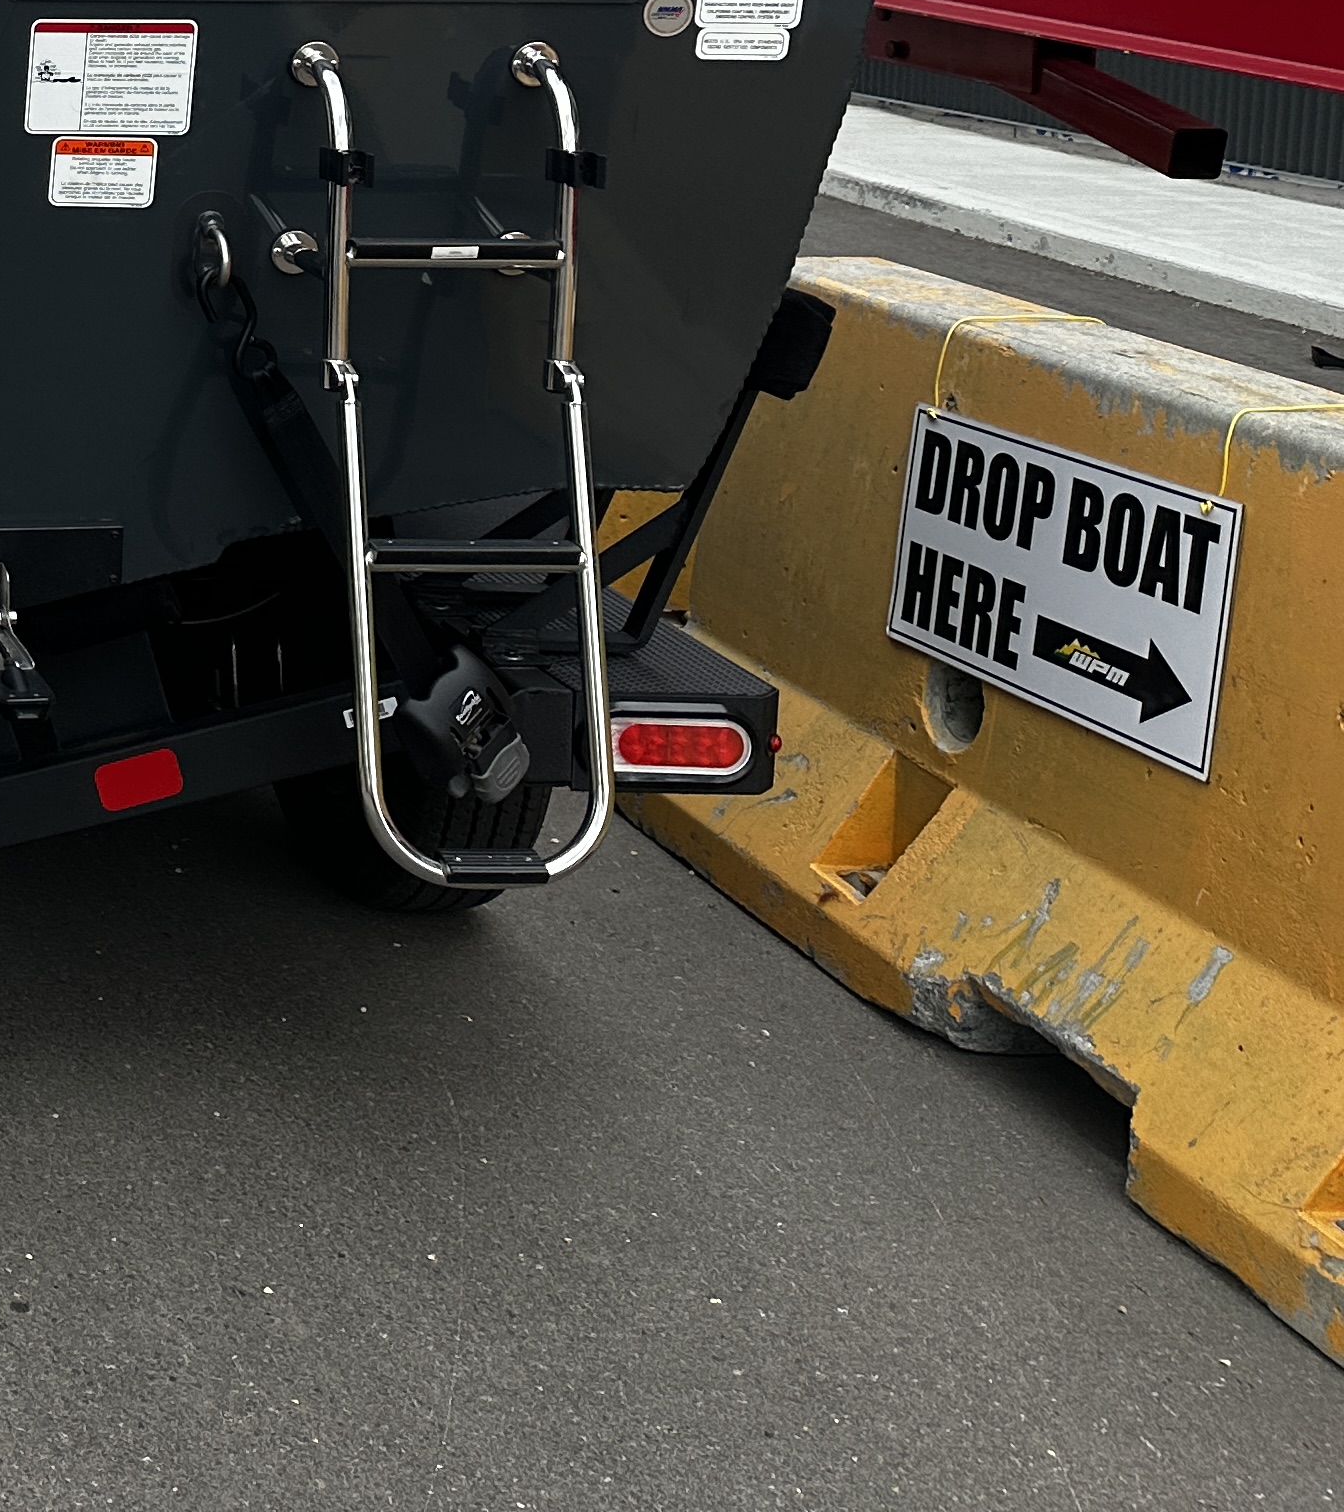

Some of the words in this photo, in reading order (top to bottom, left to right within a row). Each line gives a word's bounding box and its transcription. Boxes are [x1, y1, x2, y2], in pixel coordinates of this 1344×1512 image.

[914, 429, 1056, 550] DROP
[1062, 477, 1221, 615] BOAT
[900, 541, 1026, 671] HERE
[1069, 650, 1130, 688] WPM
